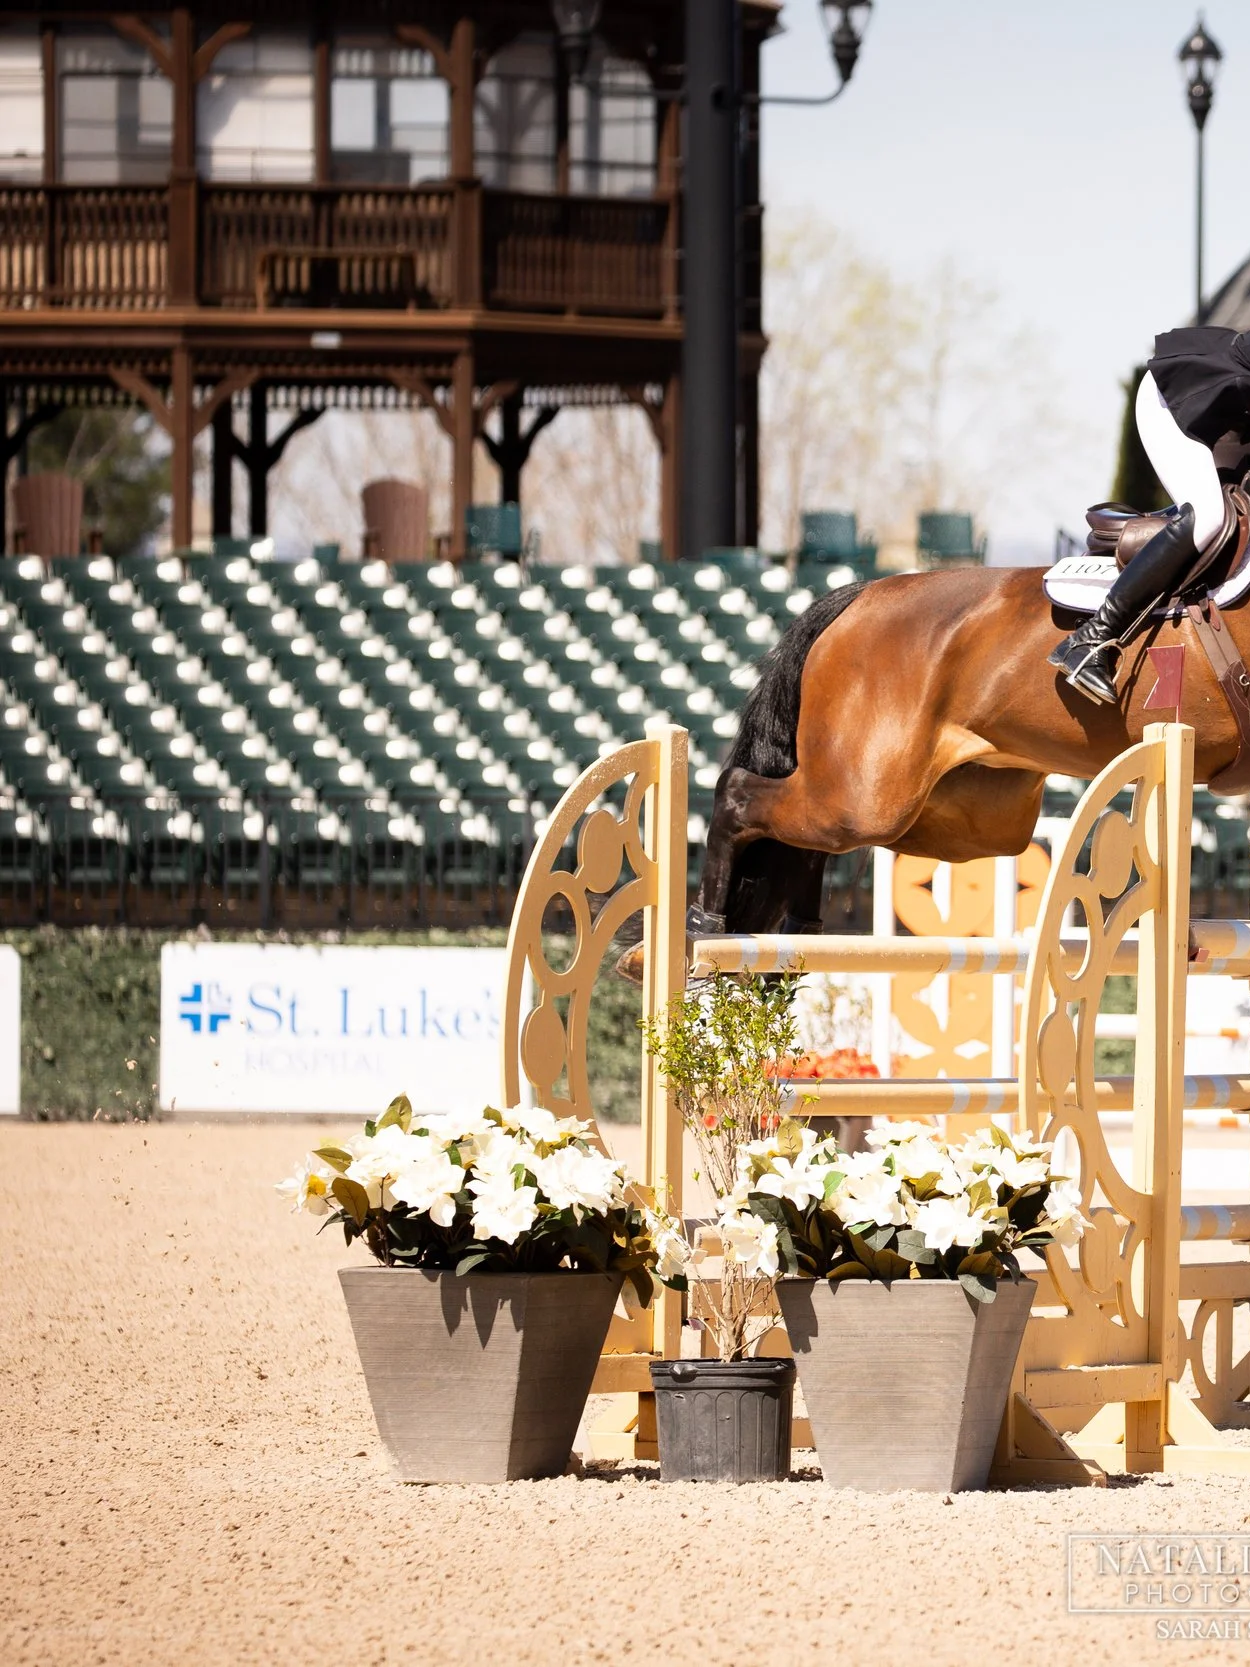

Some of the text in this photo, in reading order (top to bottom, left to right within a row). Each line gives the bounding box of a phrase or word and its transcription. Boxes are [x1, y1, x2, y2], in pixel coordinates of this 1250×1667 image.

[1062, 564, 1117, 575] 1107
[246, 981, 500, 1040] St. Luke's
[244, 1047, 385, 1076] HOSPITAL
